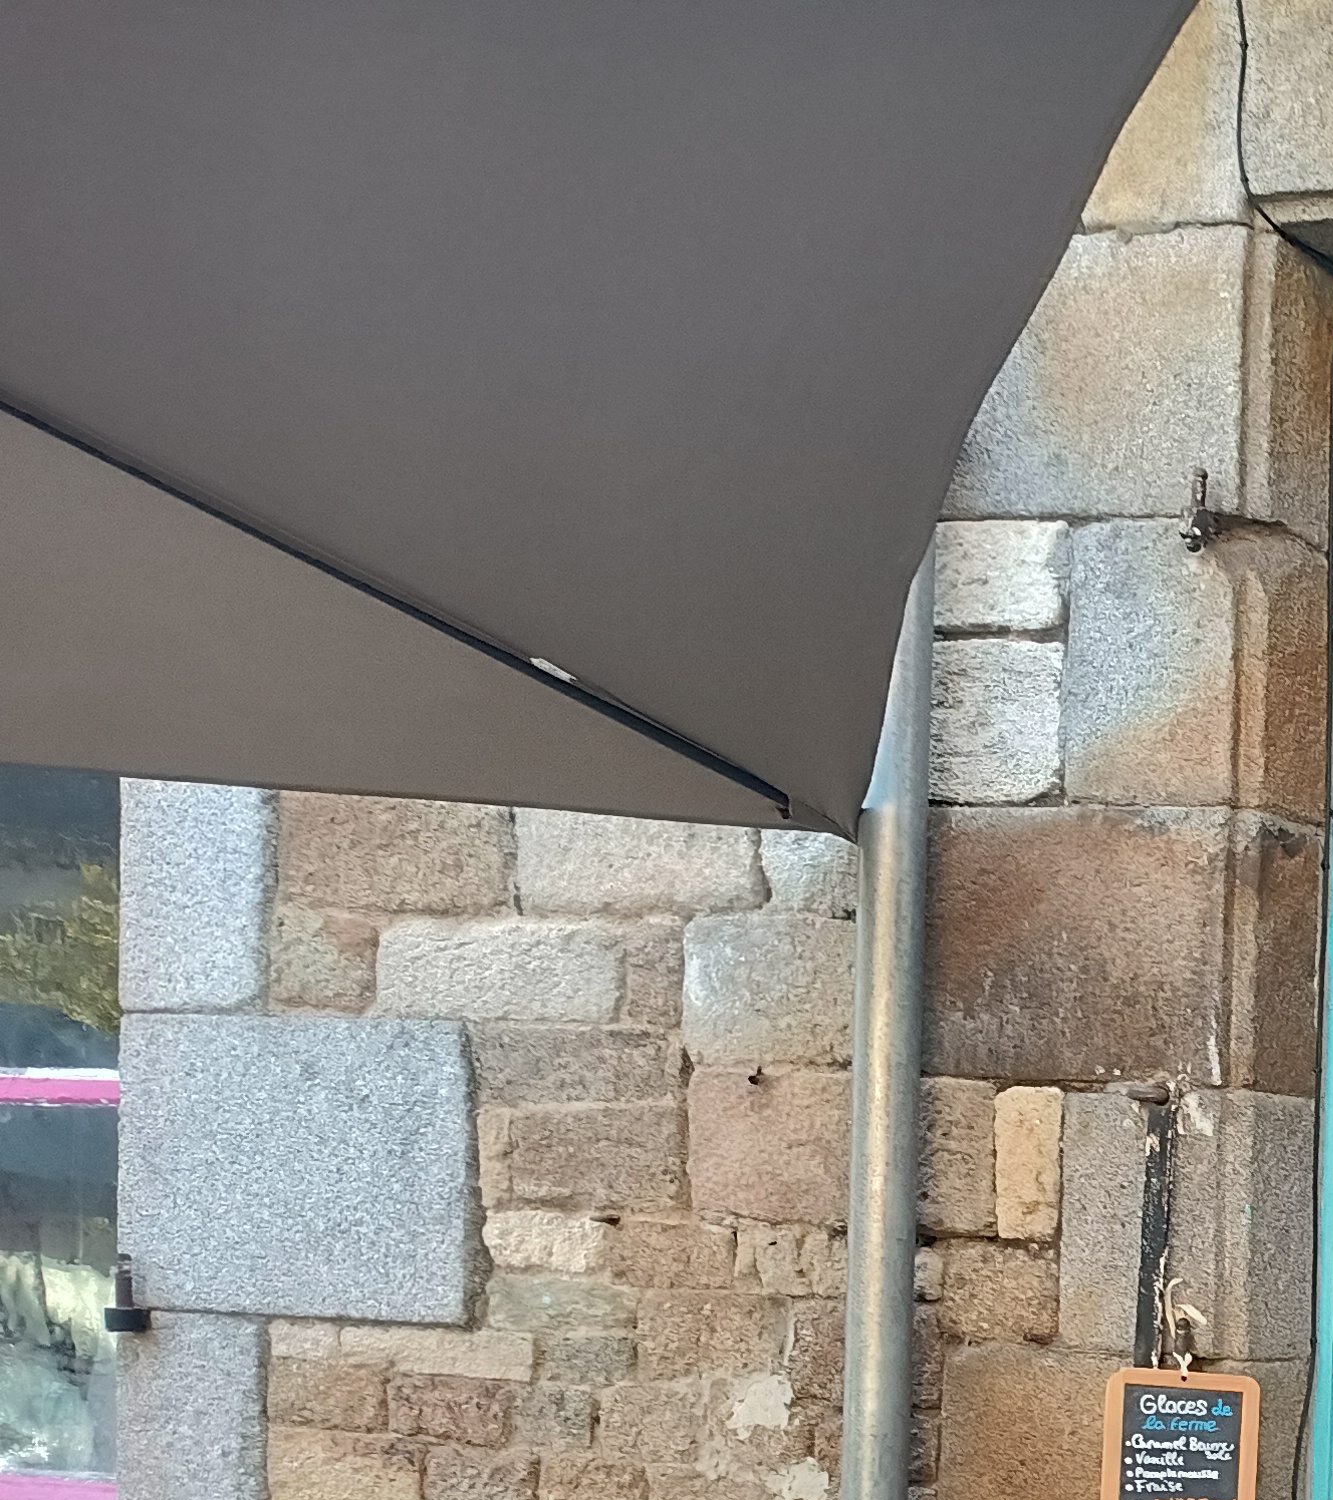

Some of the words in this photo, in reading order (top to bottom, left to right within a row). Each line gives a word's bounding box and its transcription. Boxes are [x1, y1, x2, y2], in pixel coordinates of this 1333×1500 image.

[1140, 1394, 1209, 1416] Glaces
[1211, 1399, 1233, 1417] de
[1134, 1480, 1184, 1492] Fraise
